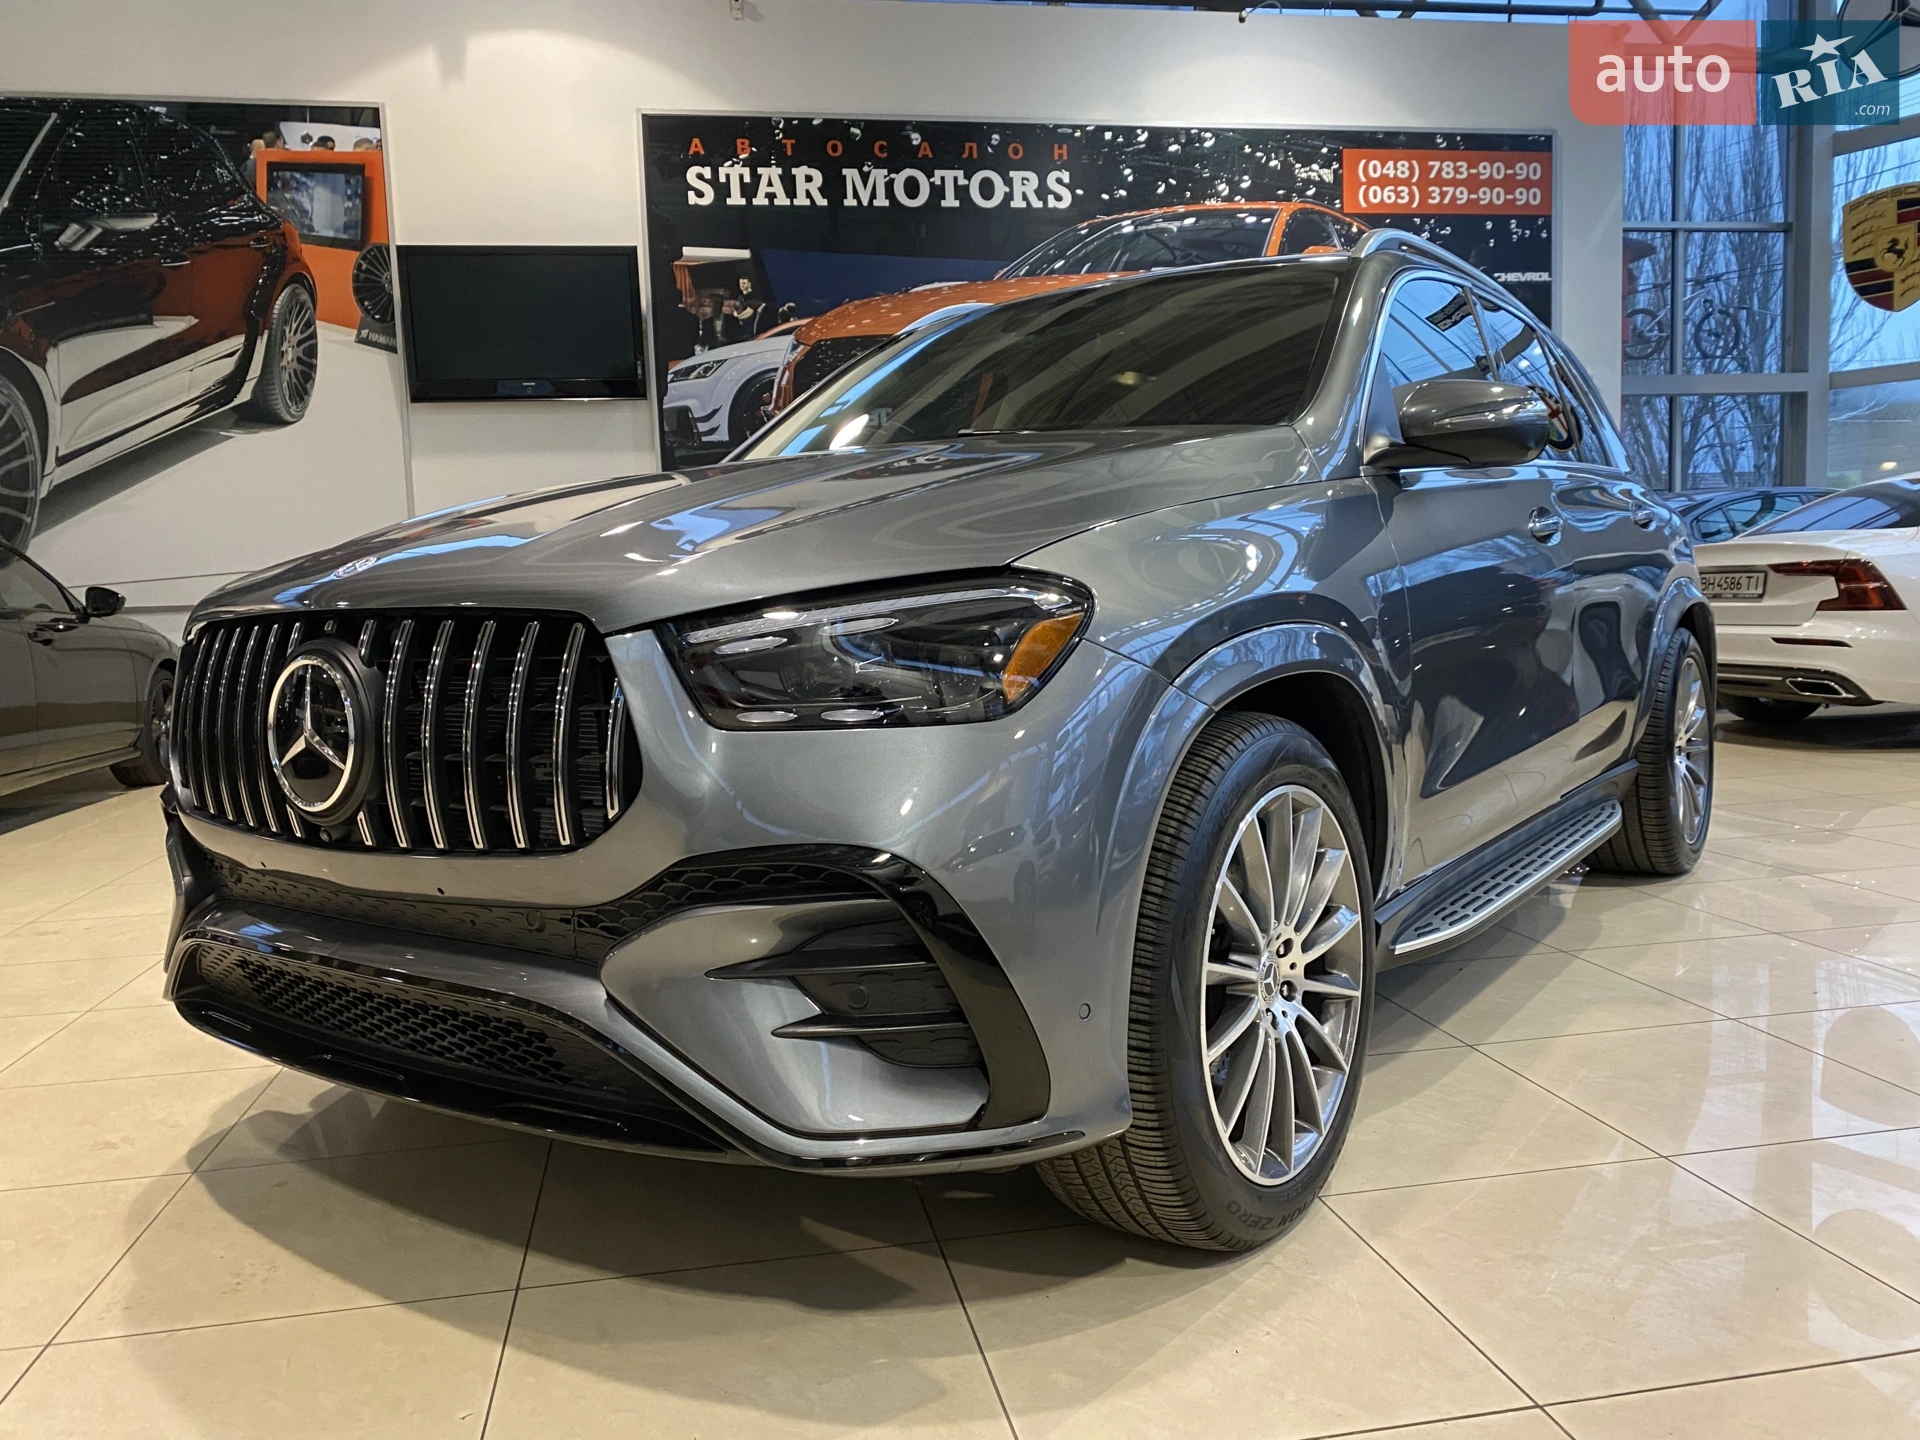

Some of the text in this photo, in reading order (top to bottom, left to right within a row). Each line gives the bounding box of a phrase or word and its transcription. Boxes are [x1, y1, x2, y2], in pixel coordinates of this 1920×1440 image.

[688, 138, 1068, 160] АВТОСАЛОН
[1358, 159, 1541, 182] (048) 783-90-90
[686, 166, 1073, 209] STAR MOTORS
[1358, 185, 1541, 207] (063) 379-90-90
[1226, 1199, 1275, 1230] ZERO
